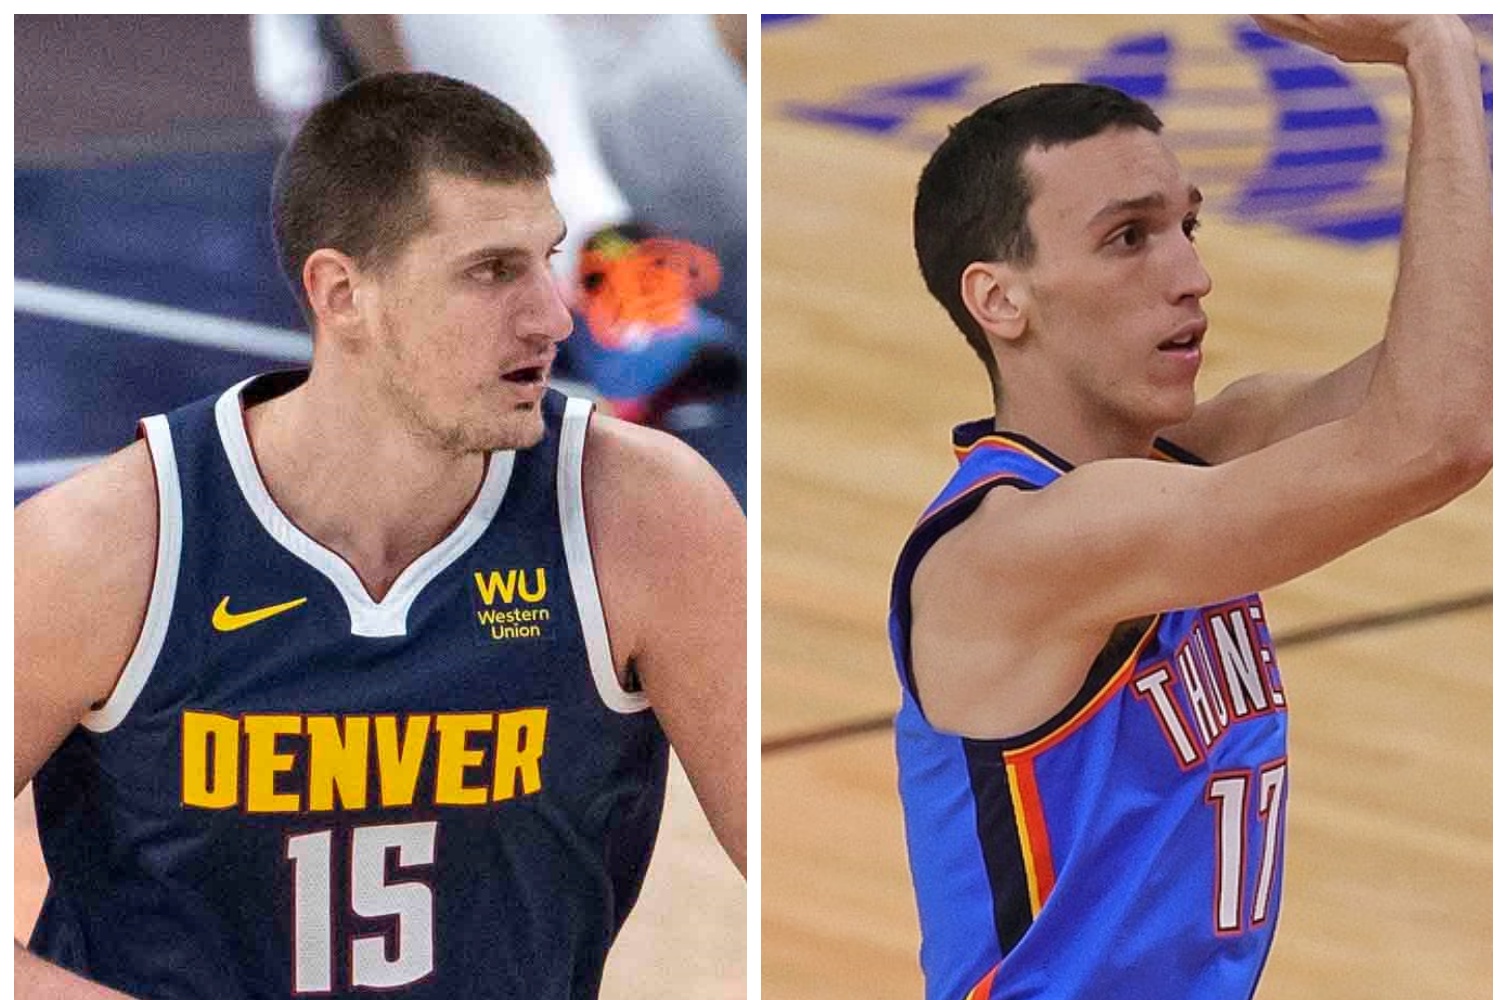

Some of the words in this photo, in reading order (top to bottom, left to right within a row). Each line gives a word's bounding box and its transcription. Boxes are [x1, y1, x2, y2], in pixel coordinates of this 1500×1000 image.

[473, 567, 547, 606] WU
[477, 607, 550, 626] Western
[490, 622, 541, 640] Union
[180, 707, 549, 812] DENVER
[1208, 760, 1286, 934] 17
[285, 820, 438, 993] 15
